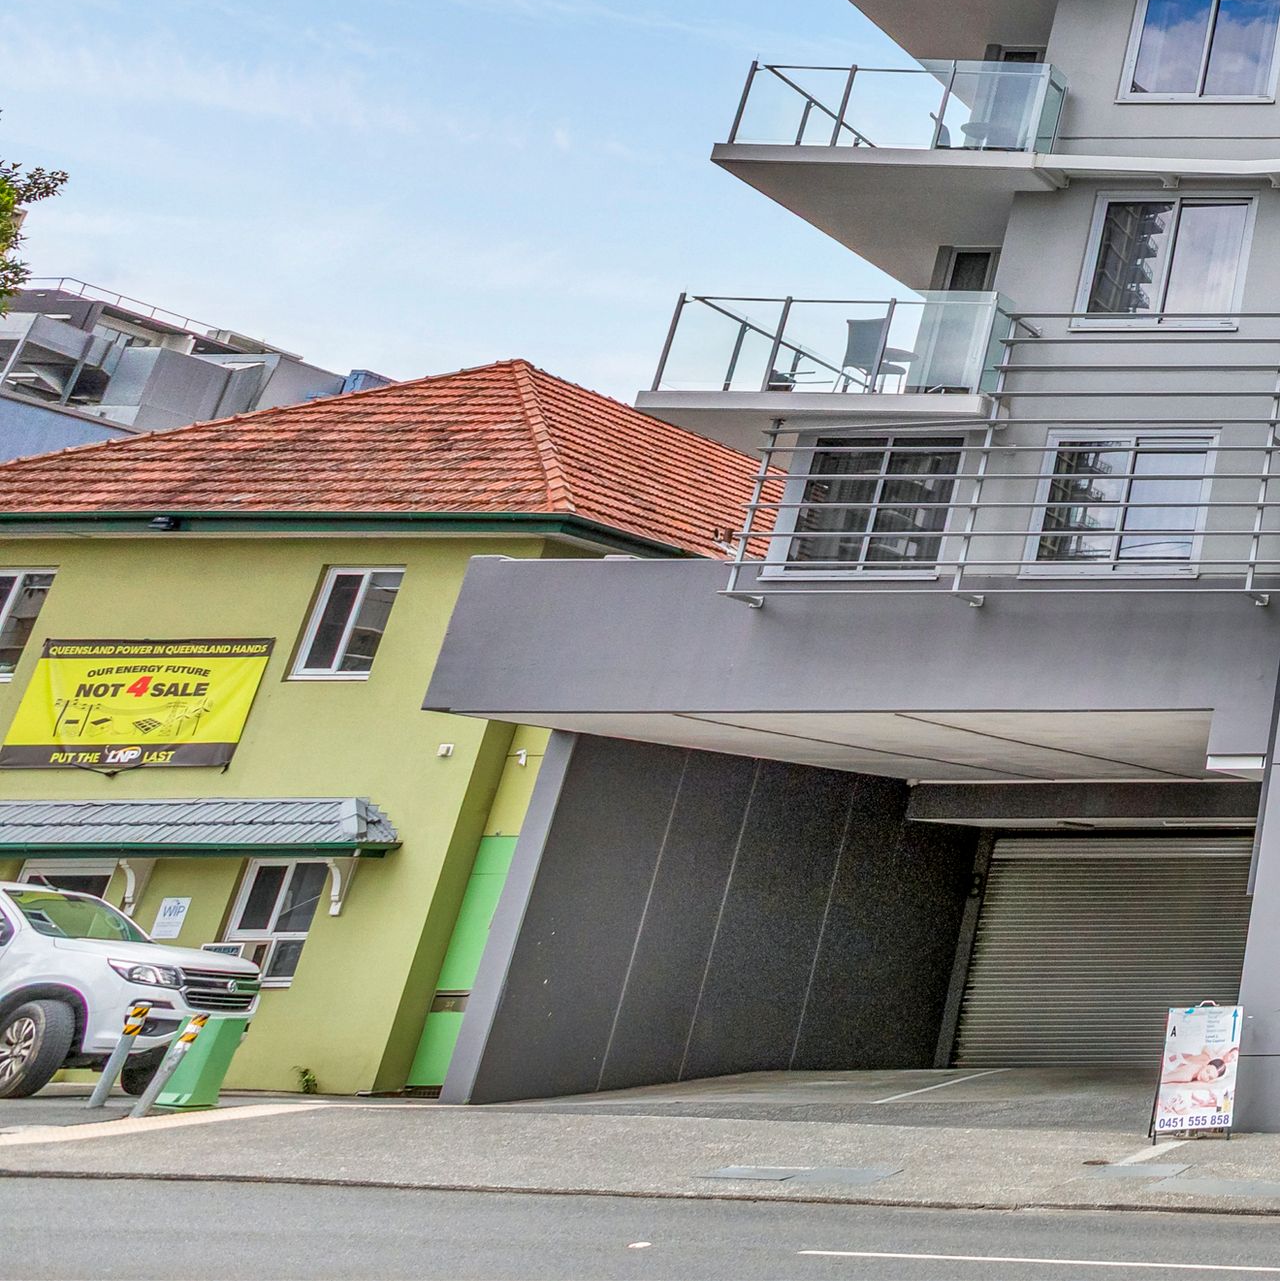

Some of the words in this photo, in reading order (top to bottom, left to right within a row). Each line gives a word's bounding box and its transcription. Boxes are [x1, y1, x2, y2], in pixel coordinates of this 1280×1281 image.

[49, 646, 114, 655] QUEENSLAND
[116, 646, 151, 655] POWER
[153, 645, 164, 654] IN
[165, 645, 231, 655] QUEENSLAND
[233, 644, 268, 653] HANDS
[87, 666, 113, 677] OUR
[115, 665, 162, 674] ENERGY
[165, 665, 211, 677] FUTURE
[75, 683, 125, 697] NOT
[126, 675, 153, 697] 4
[150, 683, 209, 697] SALE
[49, 753, 74, 763] PUT
[75, 752, 100, 763] THE
[105, 749, 140, 763] LNP
[141, 751, 175, 762] LAST
[1158, 1117, 1184, 1129] 0451
[1188, 1115, 1207, 1127] 555
[1210, 1114, 1230, 1126] 858
